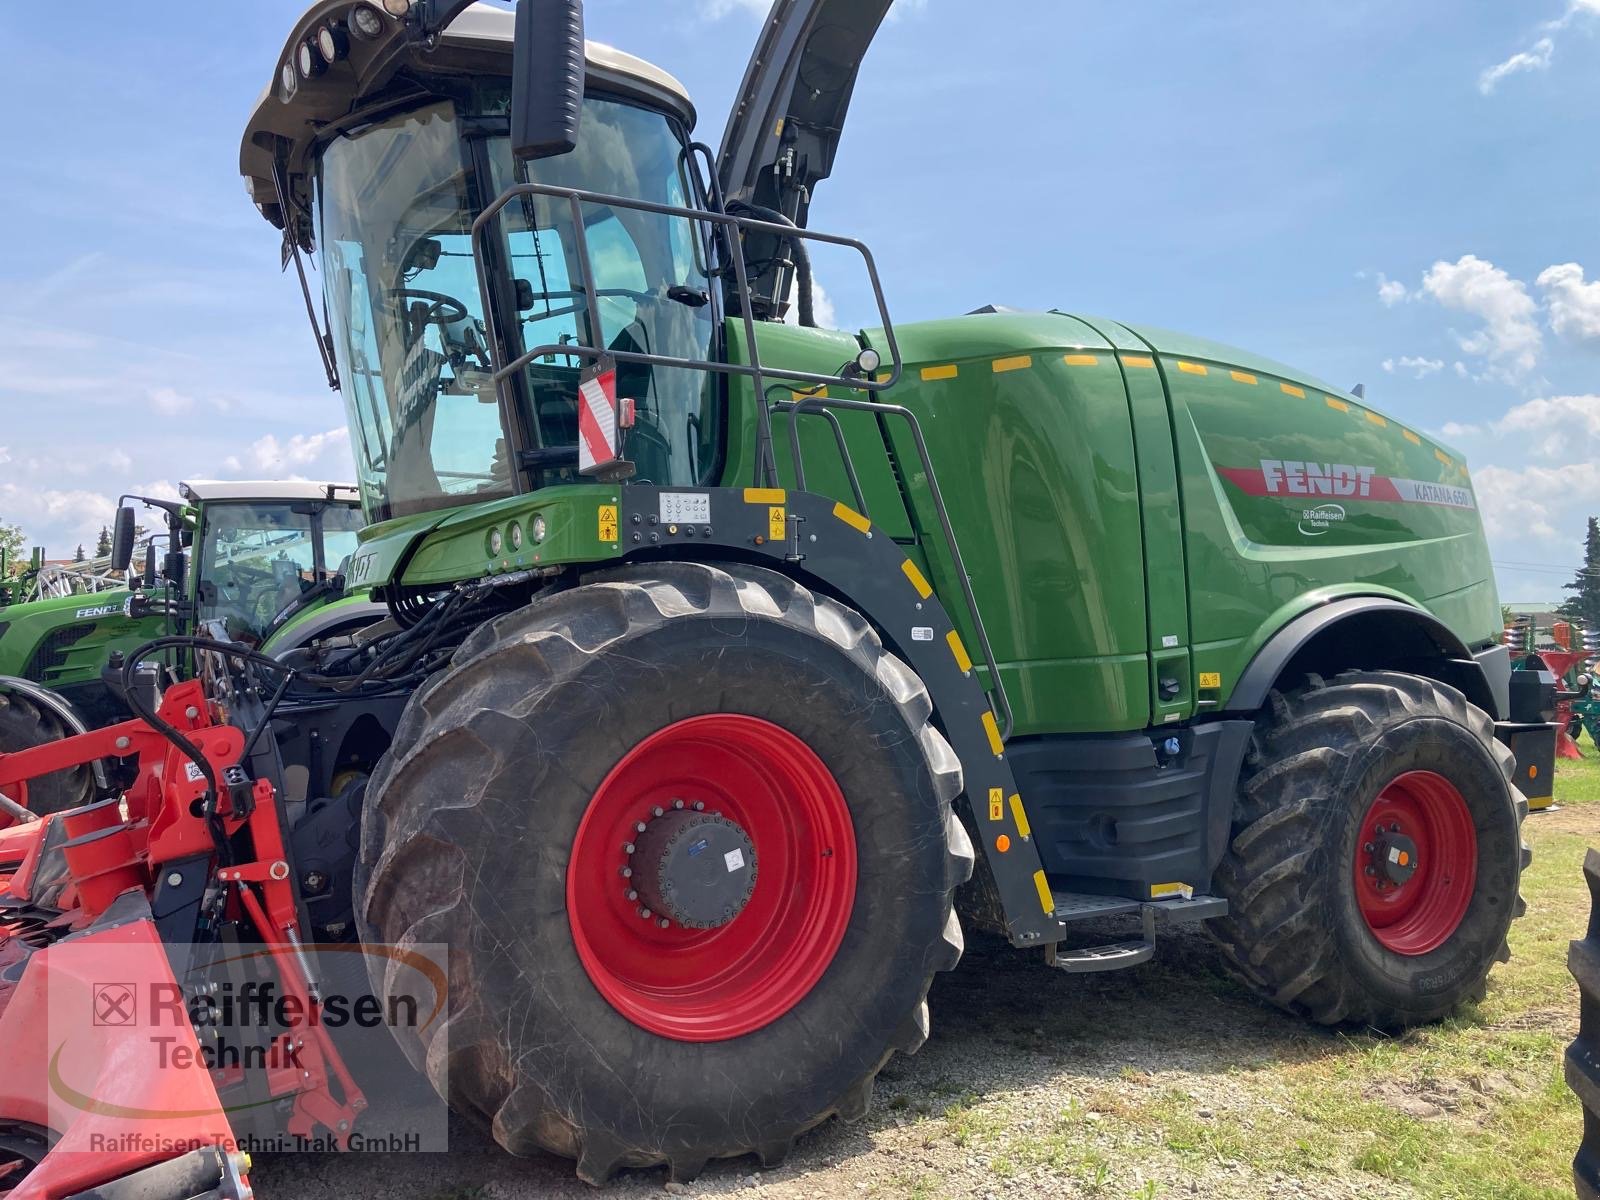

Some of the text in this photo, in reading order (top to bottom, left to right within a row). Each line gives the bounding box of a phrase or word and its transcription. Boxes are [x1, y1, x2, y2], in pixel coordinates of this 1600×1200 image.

[1260, 459, 1376, 497] FENDT
[1414, 484, 1468, 505] KATANA 650
[1310, 510, 1343, 520] Raiffeisen
